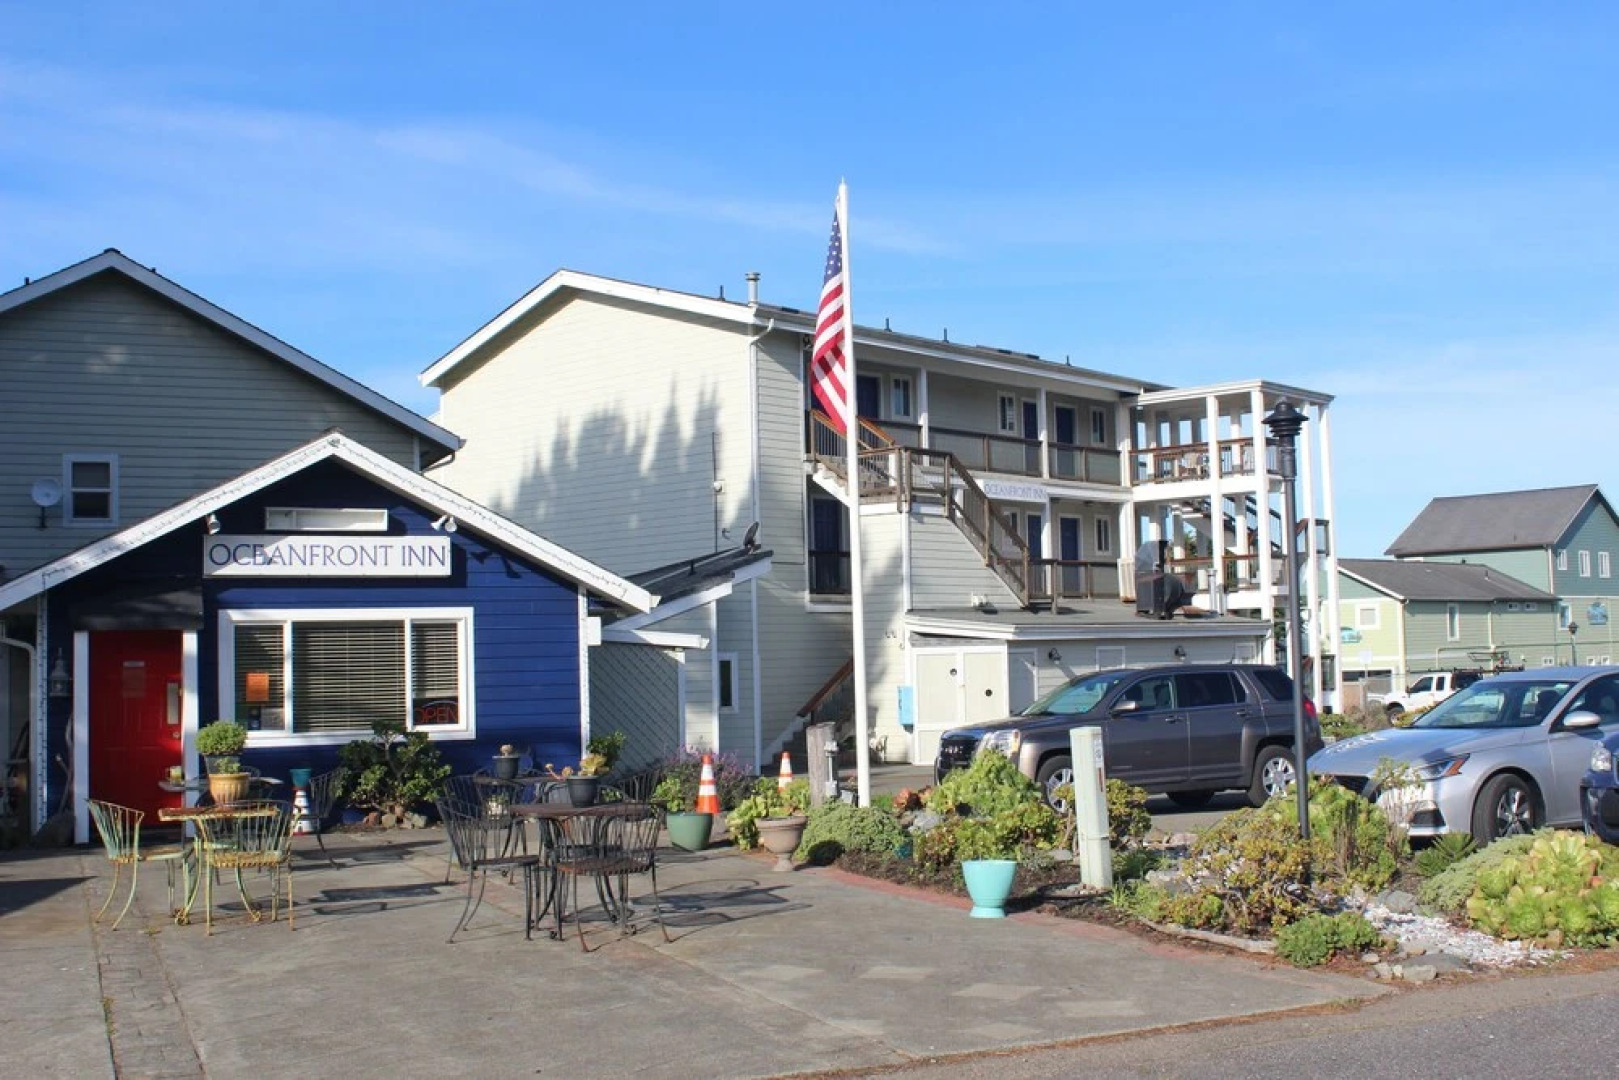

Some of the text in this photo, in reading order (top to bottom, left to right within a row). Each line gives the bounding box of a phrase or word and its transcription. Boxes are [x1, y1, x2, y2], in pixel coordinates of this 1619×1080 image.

[209, 543, 446, 567] OCEANFRONT INN
[414, 706, 458, 723] OPEN
